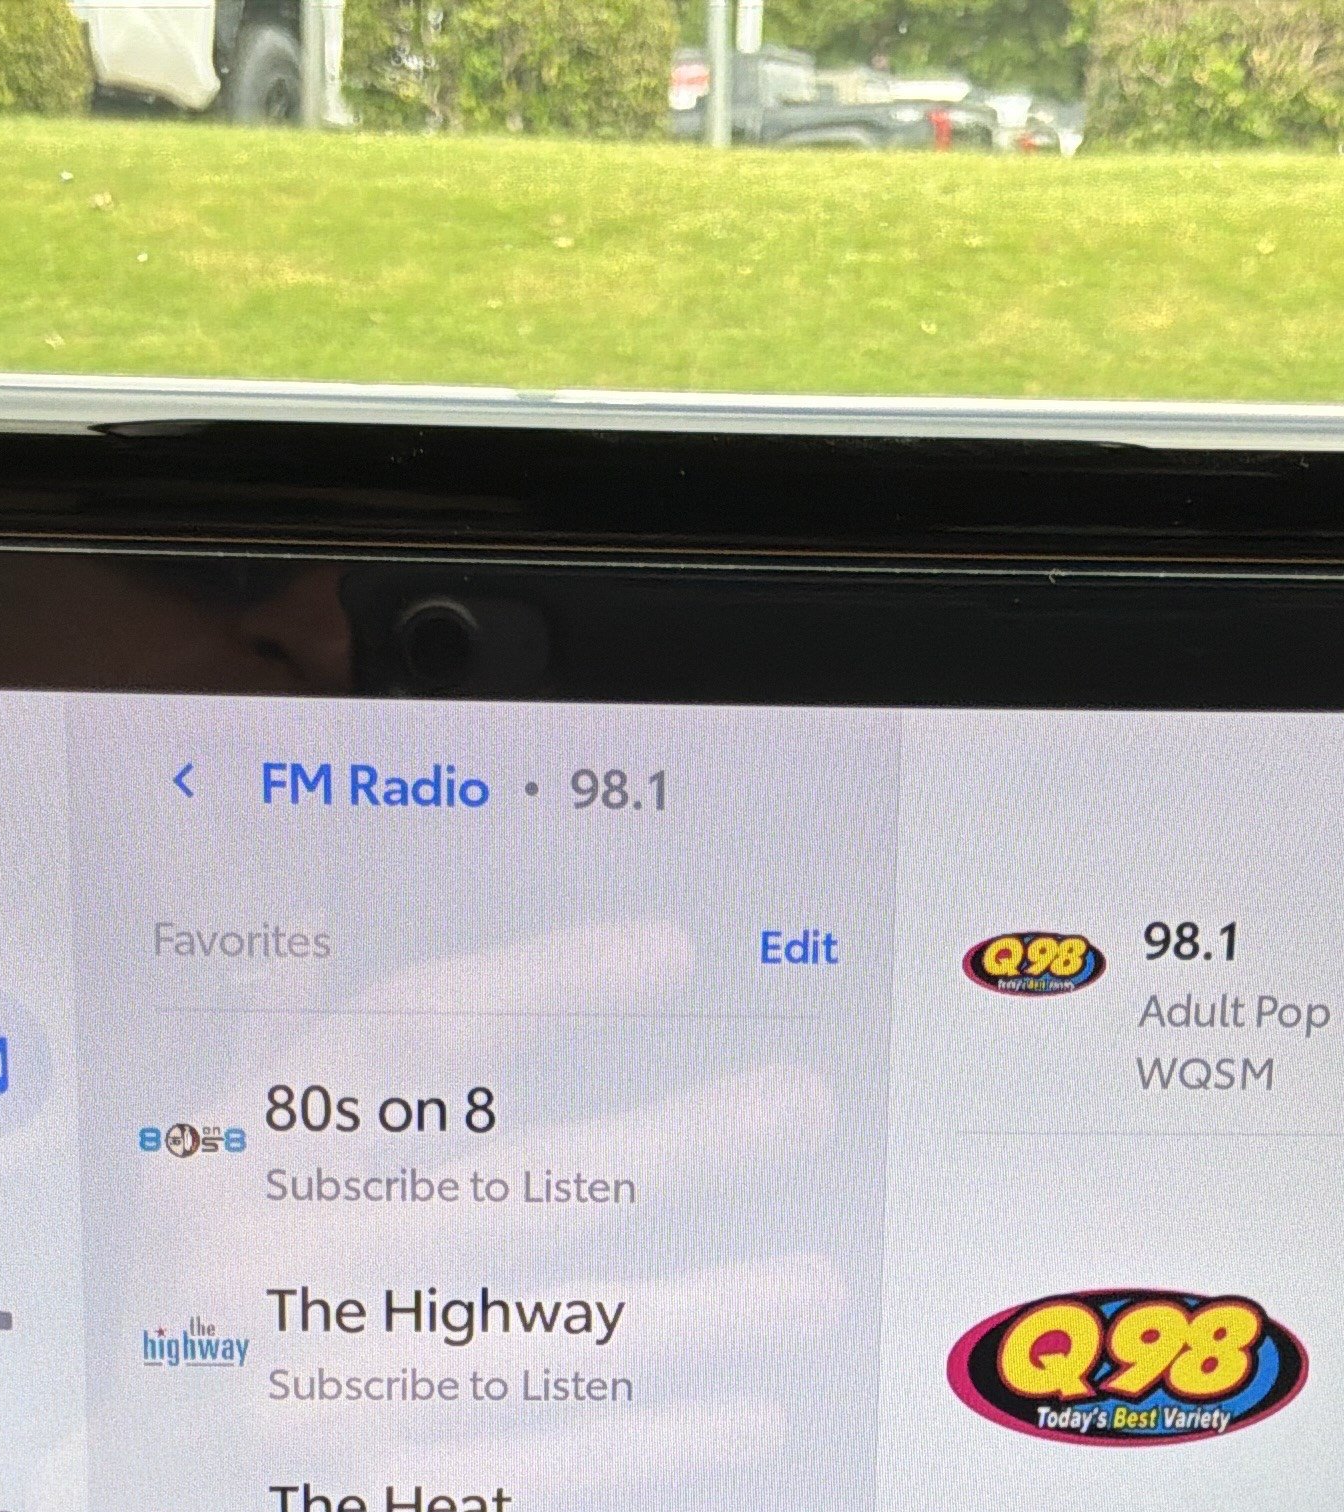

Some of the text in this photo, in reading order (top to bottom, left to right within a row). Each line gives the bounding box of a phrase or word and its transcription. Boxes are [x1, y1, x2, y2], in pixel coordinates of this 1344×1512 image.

[263, 762, 665, 810] FM Radio 98.1
[154, 921, 331, 958] Favorites
[761, 930, 837, 964] Edit
[1144, 921, 1236, 960] 98.1
[1138, 993, 1331, 1037] Adult Pop
[1136, 1057, 1274, 1090] WQSM
[266, 1084, 495, 1133] 80s on 8
[267, 1167, 636, 1203] Subscribe to Listen
[189, 1316, 215, 1336] the
[267, 1286, 624, 1346] The Highway
[143, 1329, 250, 1367] highway
[269, 1368, 633, 1401] Subscribe to Listen
[1037, 1406, 1231, 1433] Today's Best Variety
